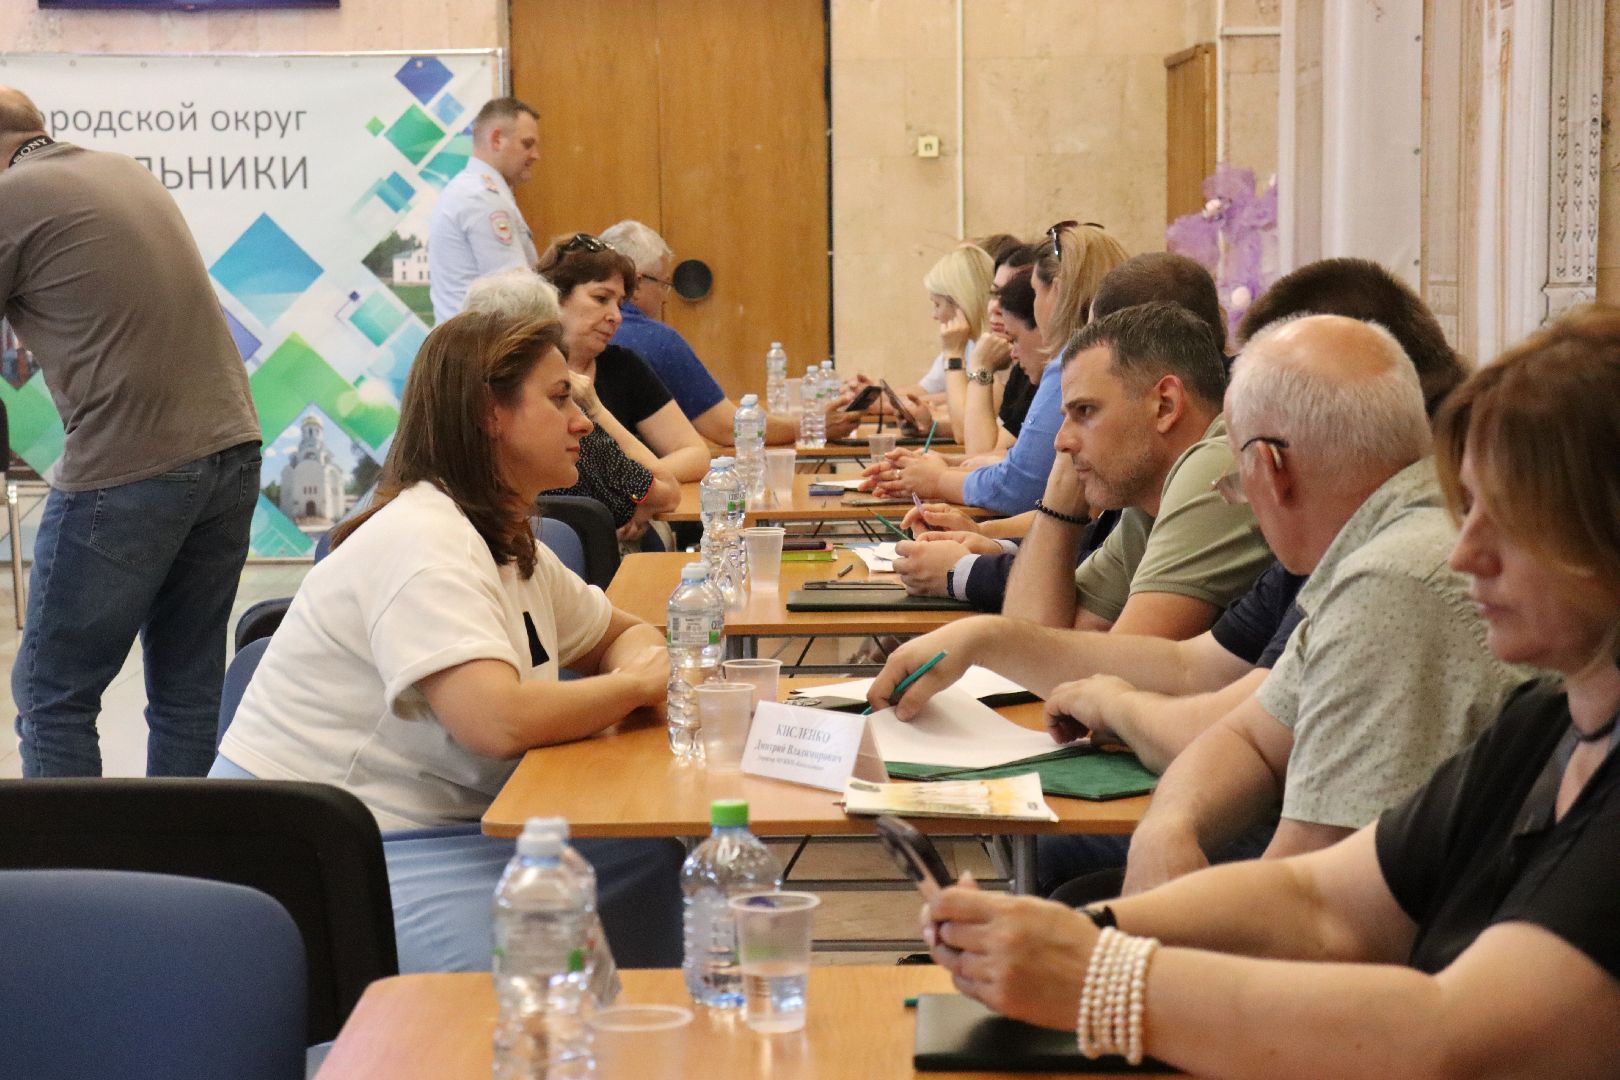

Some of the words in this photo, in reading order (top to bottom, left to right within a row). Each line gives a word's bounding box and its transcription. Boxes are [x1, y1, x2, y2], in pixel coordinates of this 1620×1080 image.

[41, 101, 198, 138] родской
[211, 110, 307, 139] округ
[13, 137, 48, 164] SONY
[776, 723, 831, 744] КИСЛЕНКО
[754, 739, 786, 754] Дмитрий
[787, 744, 842, 763] Владимирович
